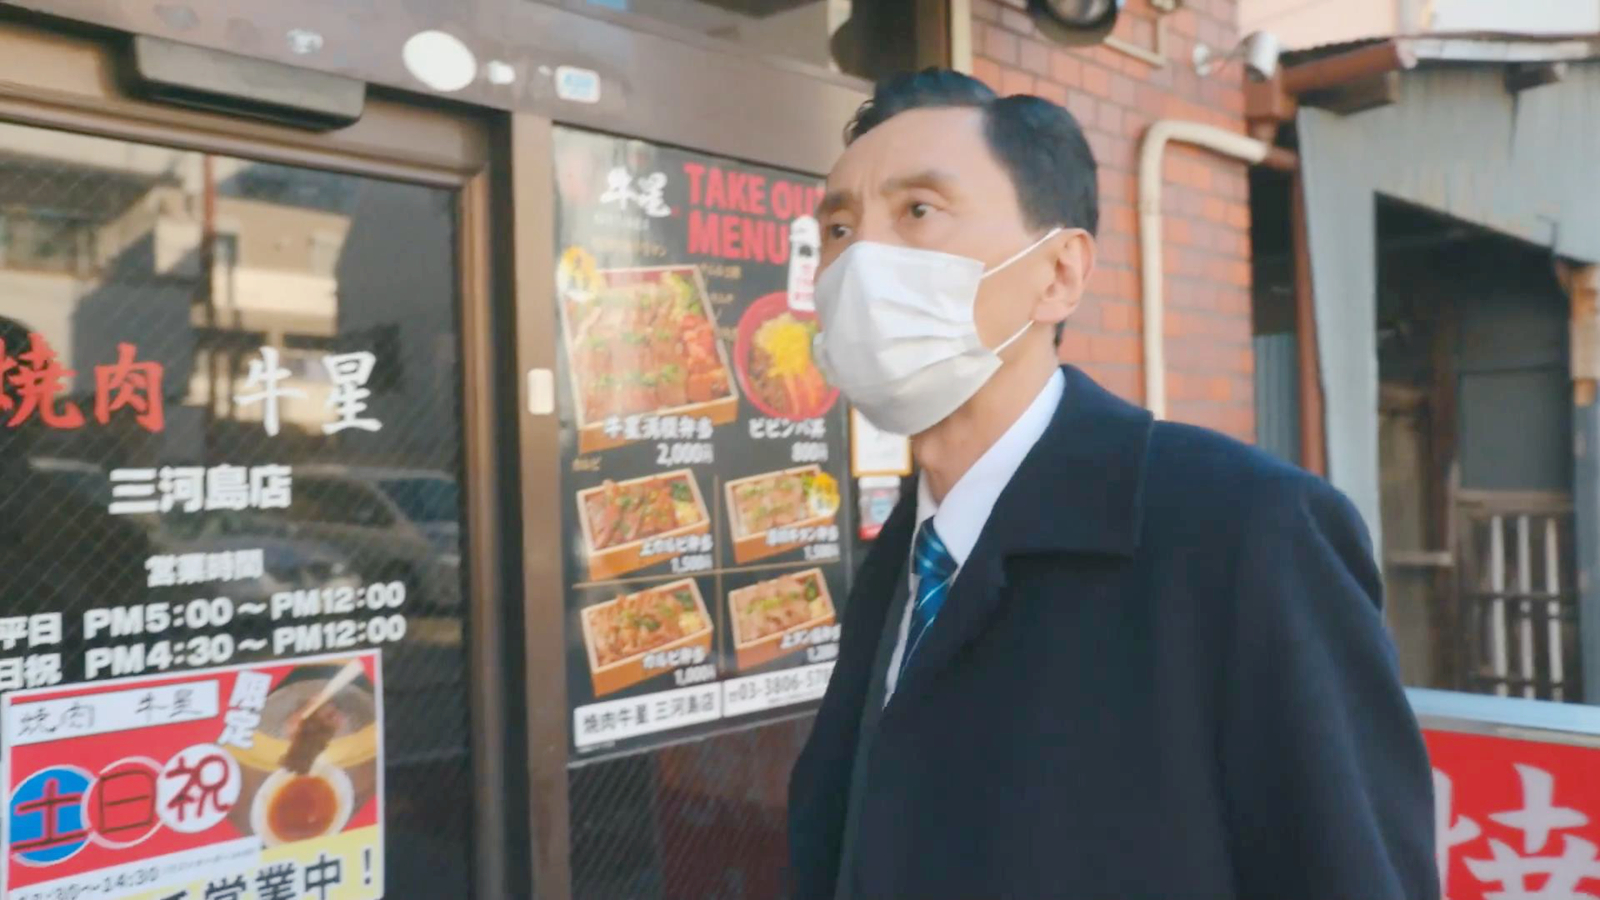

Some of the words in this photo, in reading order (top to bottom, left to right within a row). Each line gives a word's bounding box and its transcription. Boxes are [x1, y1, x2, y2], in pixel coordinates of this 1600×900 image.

[683, 162, 766, 215] TAKE
[687, 209, 790, 265] MENU
[0, 332, 165, 433] 焼肉
[233, 346, 383, 437] 牛星
[108, 464, 293, 515] 三河島店
[144, 548, 265, 588] 営業時間
[0, 612, 62, 650] 平日
[18, 701, 96, 737] 焼肉
[135, 687, 205, 724] 牛星
